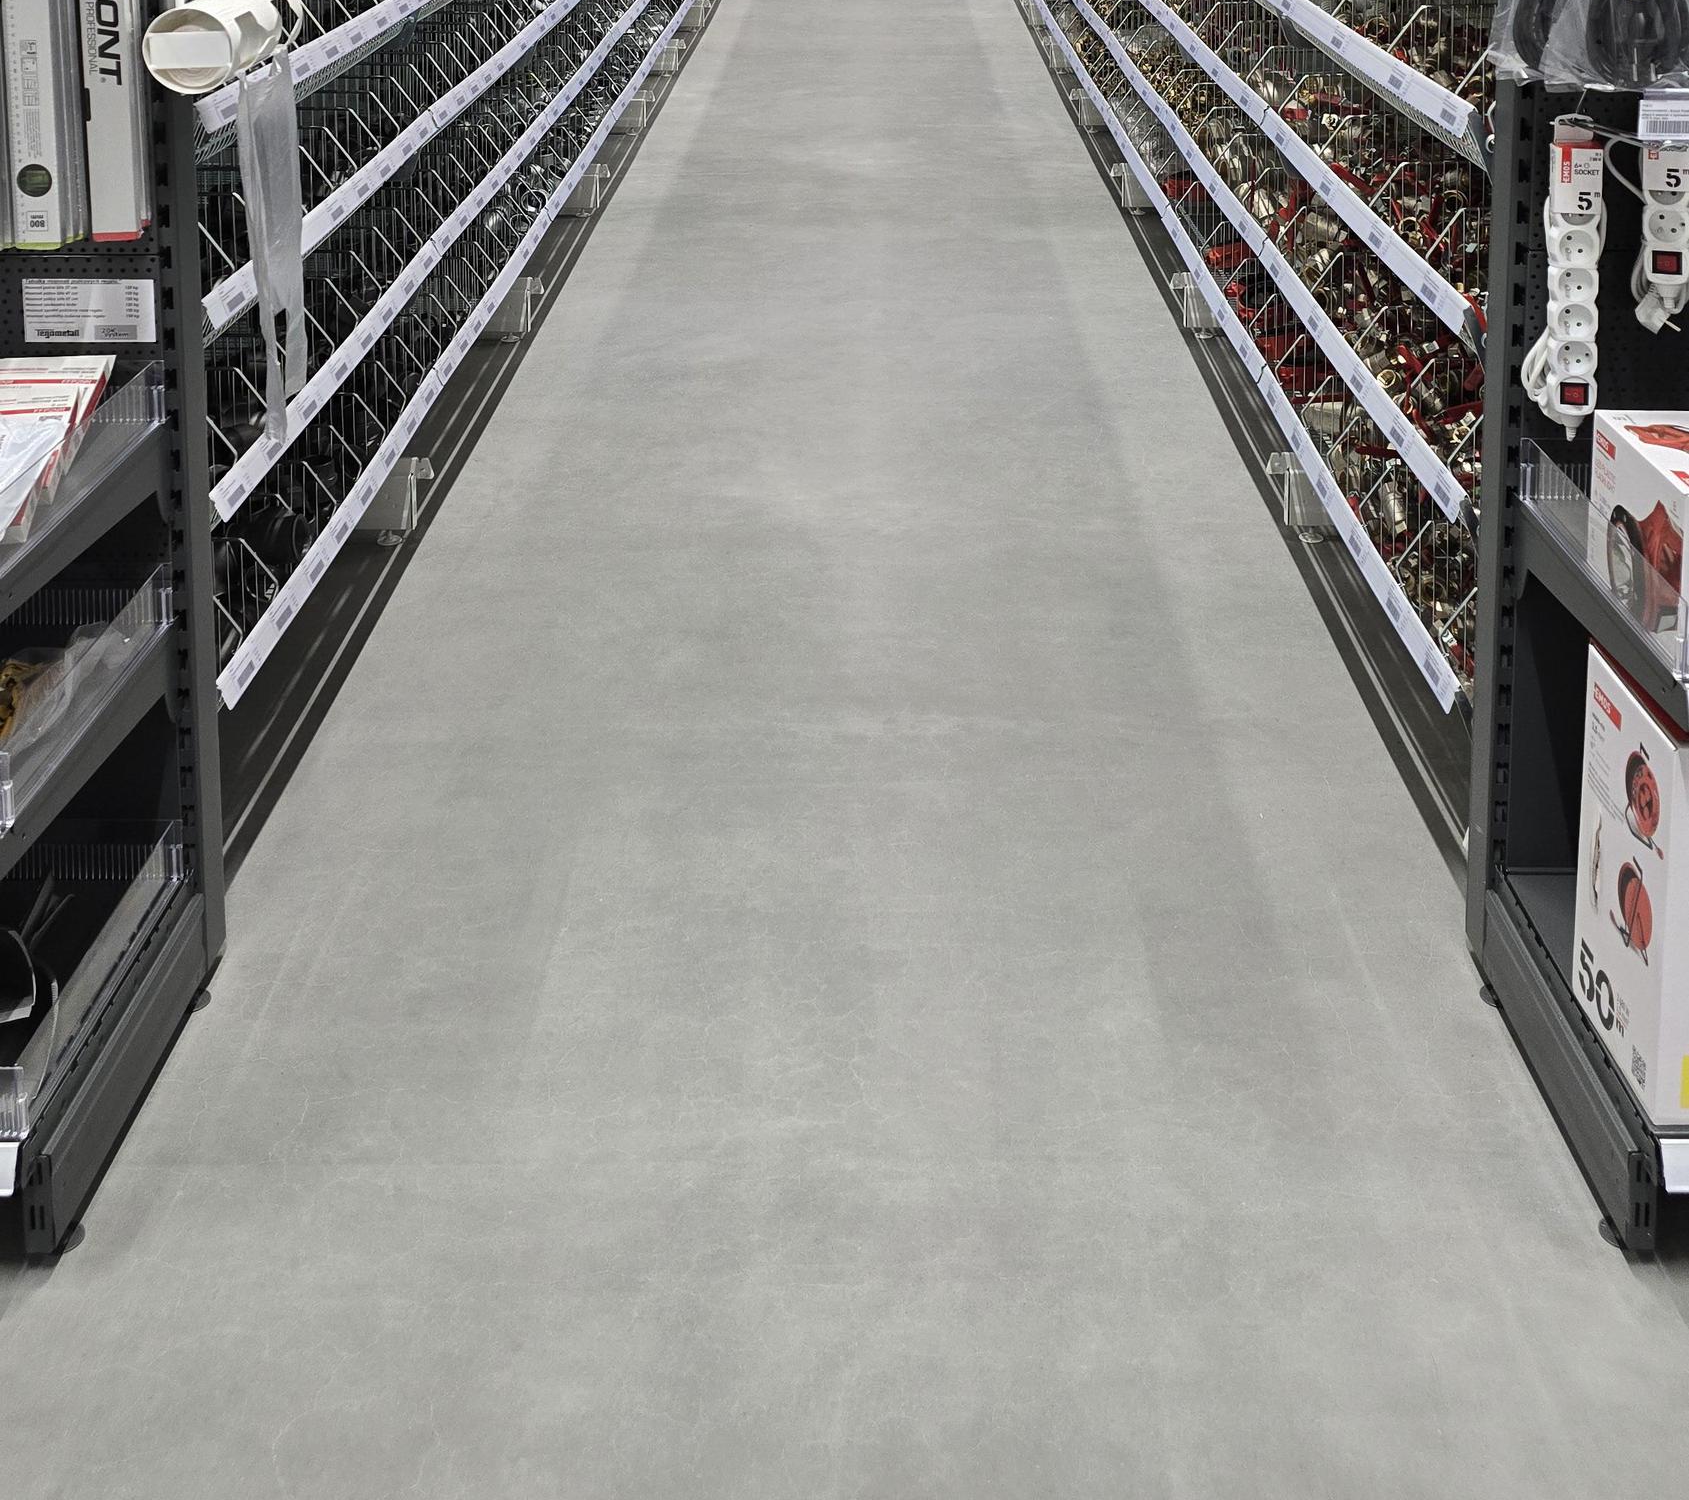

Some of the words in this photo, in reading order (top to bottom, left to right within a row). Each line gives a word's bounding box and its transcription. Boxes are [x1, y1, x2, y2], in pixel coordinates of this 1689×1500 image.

[85, 1, 98, 75] PROFESSIONAL
[1562, 161, 1570, 183] EMOS
[1665, 168, 1682, 188] 5
[1577, 192, 1593, 211] 5
[29, 219, 45, 228] 800
[1594, 685, 1612, 715] EMOS
[1579, 937, 1615, 1031] 50
